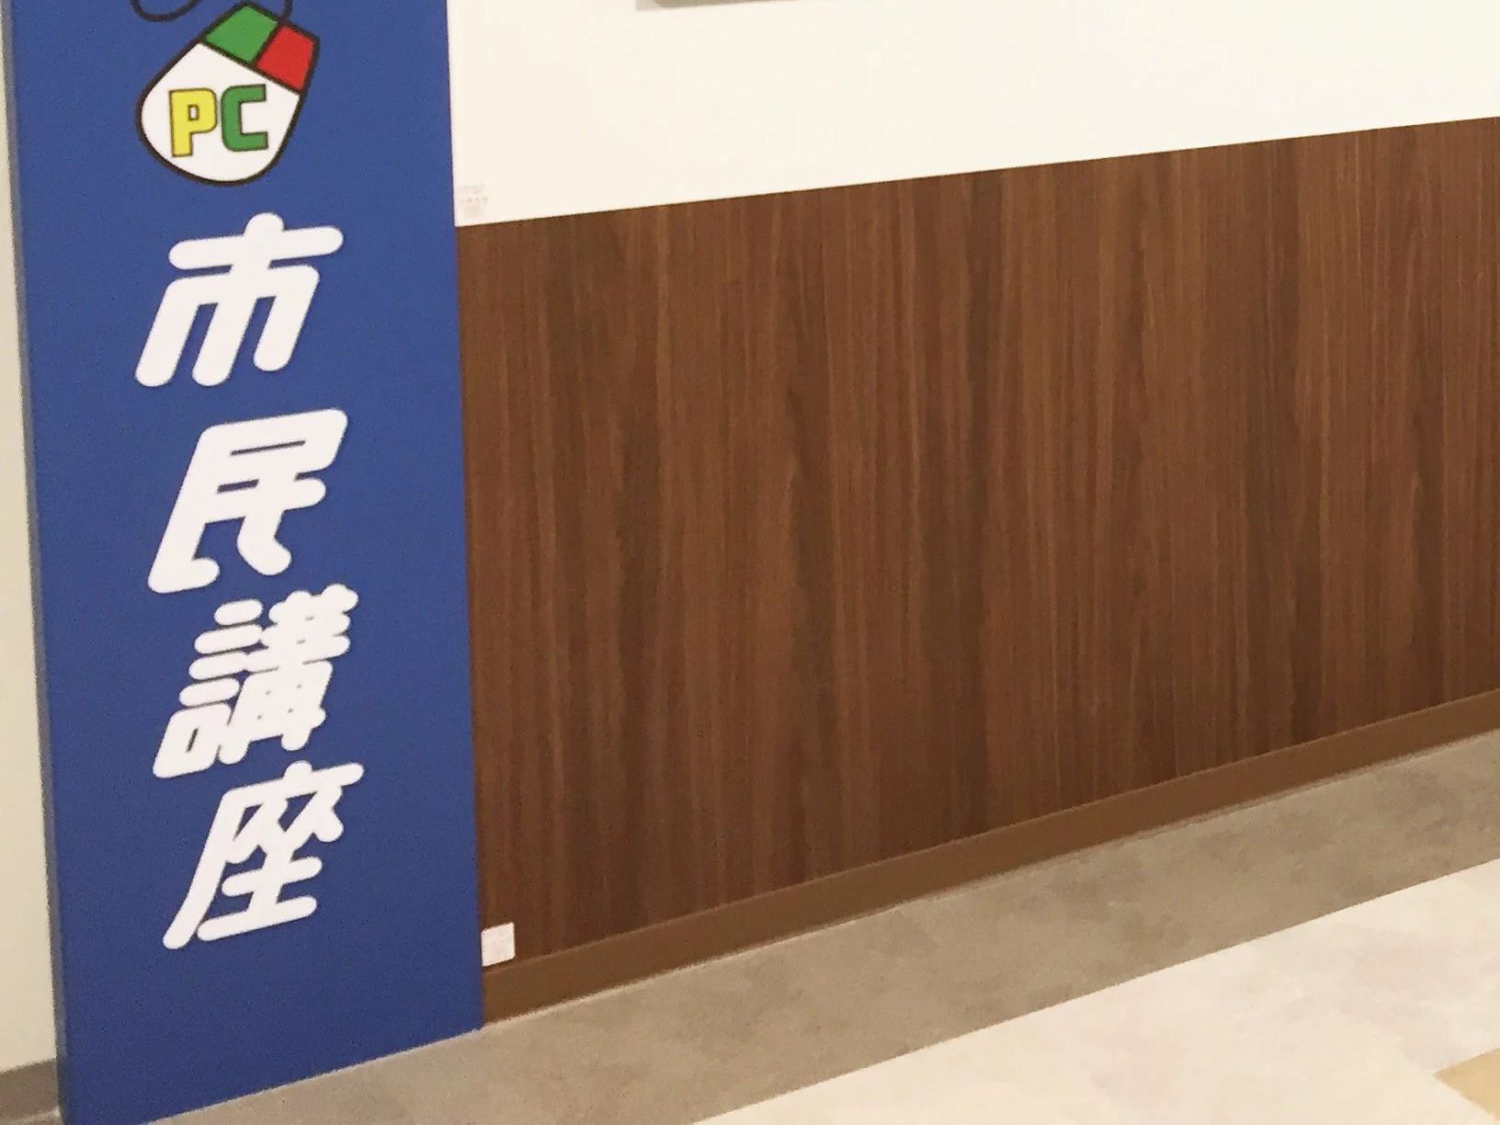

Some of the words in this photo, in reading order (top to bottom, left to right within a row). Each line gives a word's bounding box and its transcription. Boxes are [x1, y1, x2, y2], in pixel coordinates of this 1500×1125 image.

[167, 83, 270, 159] PC
[134, 212, 364, 952] 市民講座
